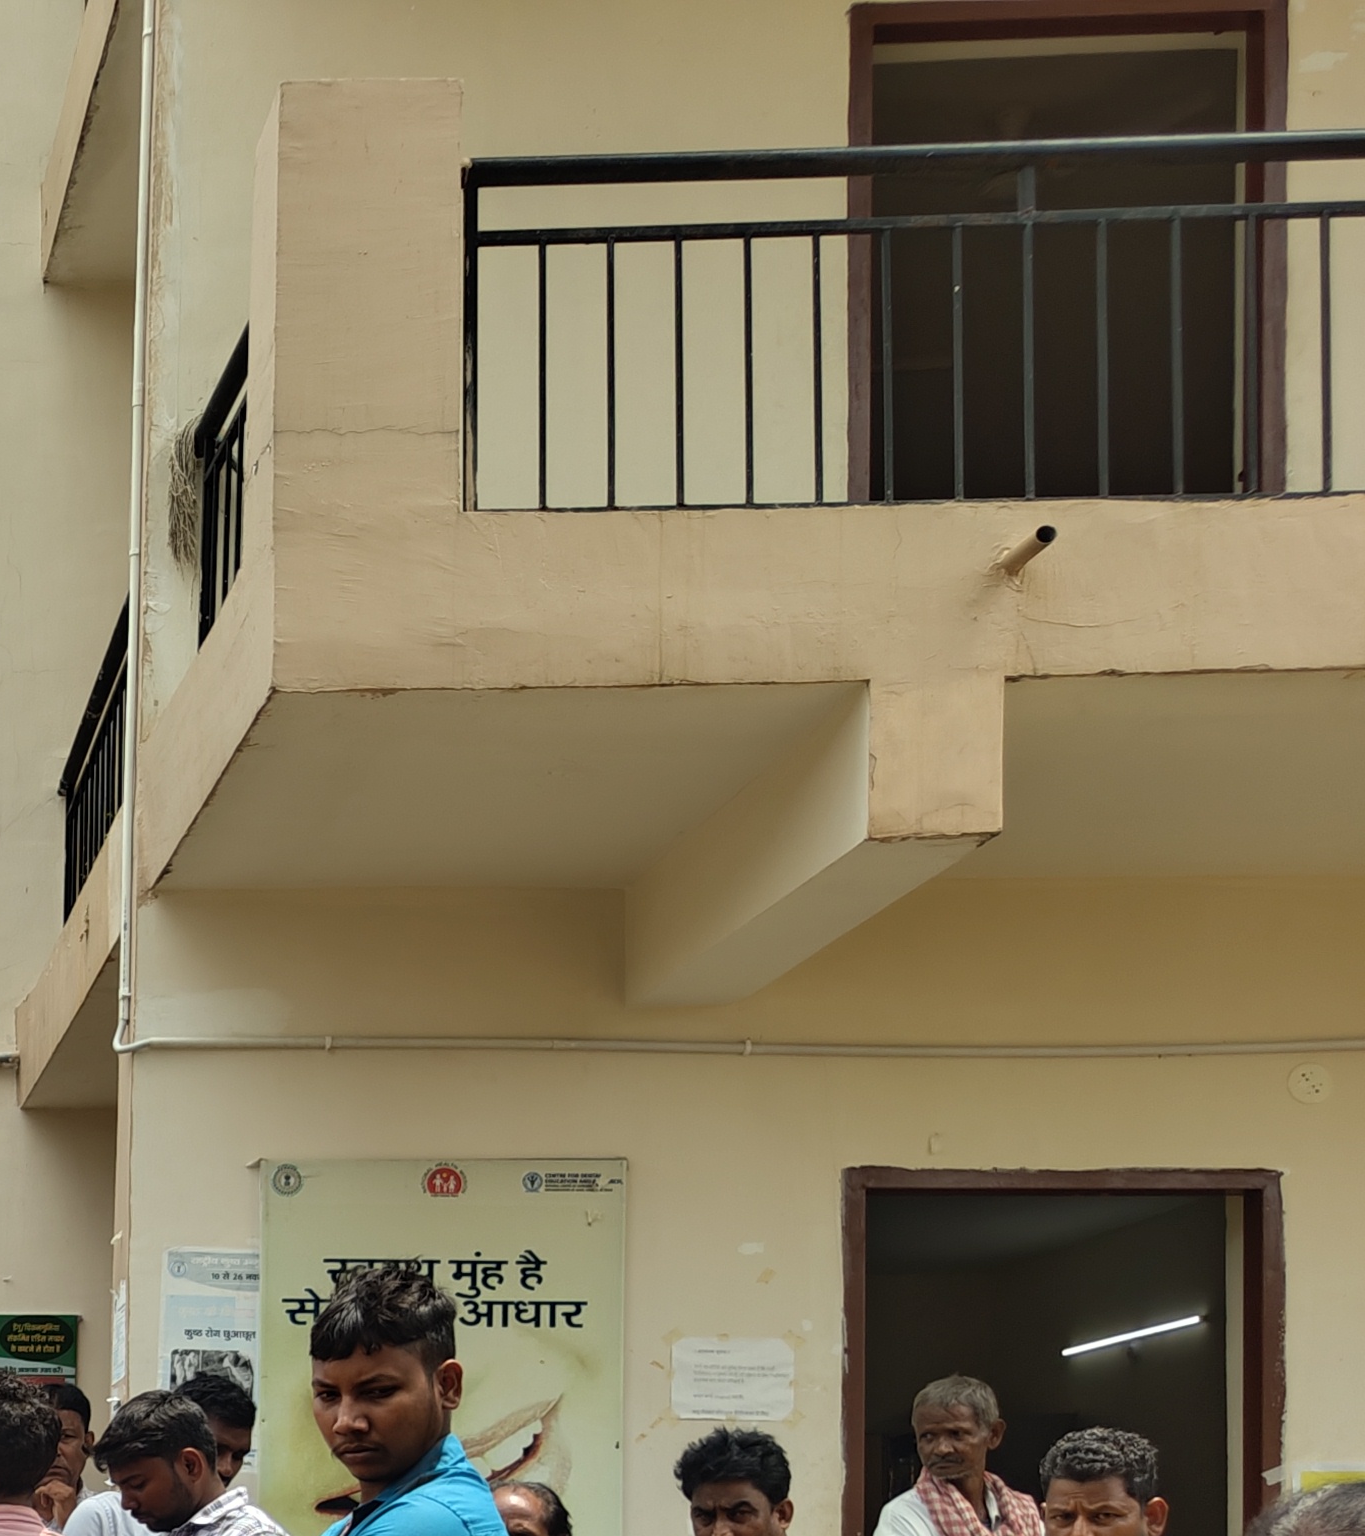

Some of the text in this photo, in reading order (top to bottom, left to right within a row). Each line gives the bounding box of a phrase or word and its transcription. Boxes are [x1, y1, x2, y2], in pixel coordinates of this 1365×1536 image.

[223, 1271, 230, 1280] से
[449, 1251, 508, 1298] मुंह
[516, 1250, 547, 1290] है
[458, 1300, 588, 1328] आधार
[184, 1327, 256, 1341] कुष्ठ रोग छुआछूत
